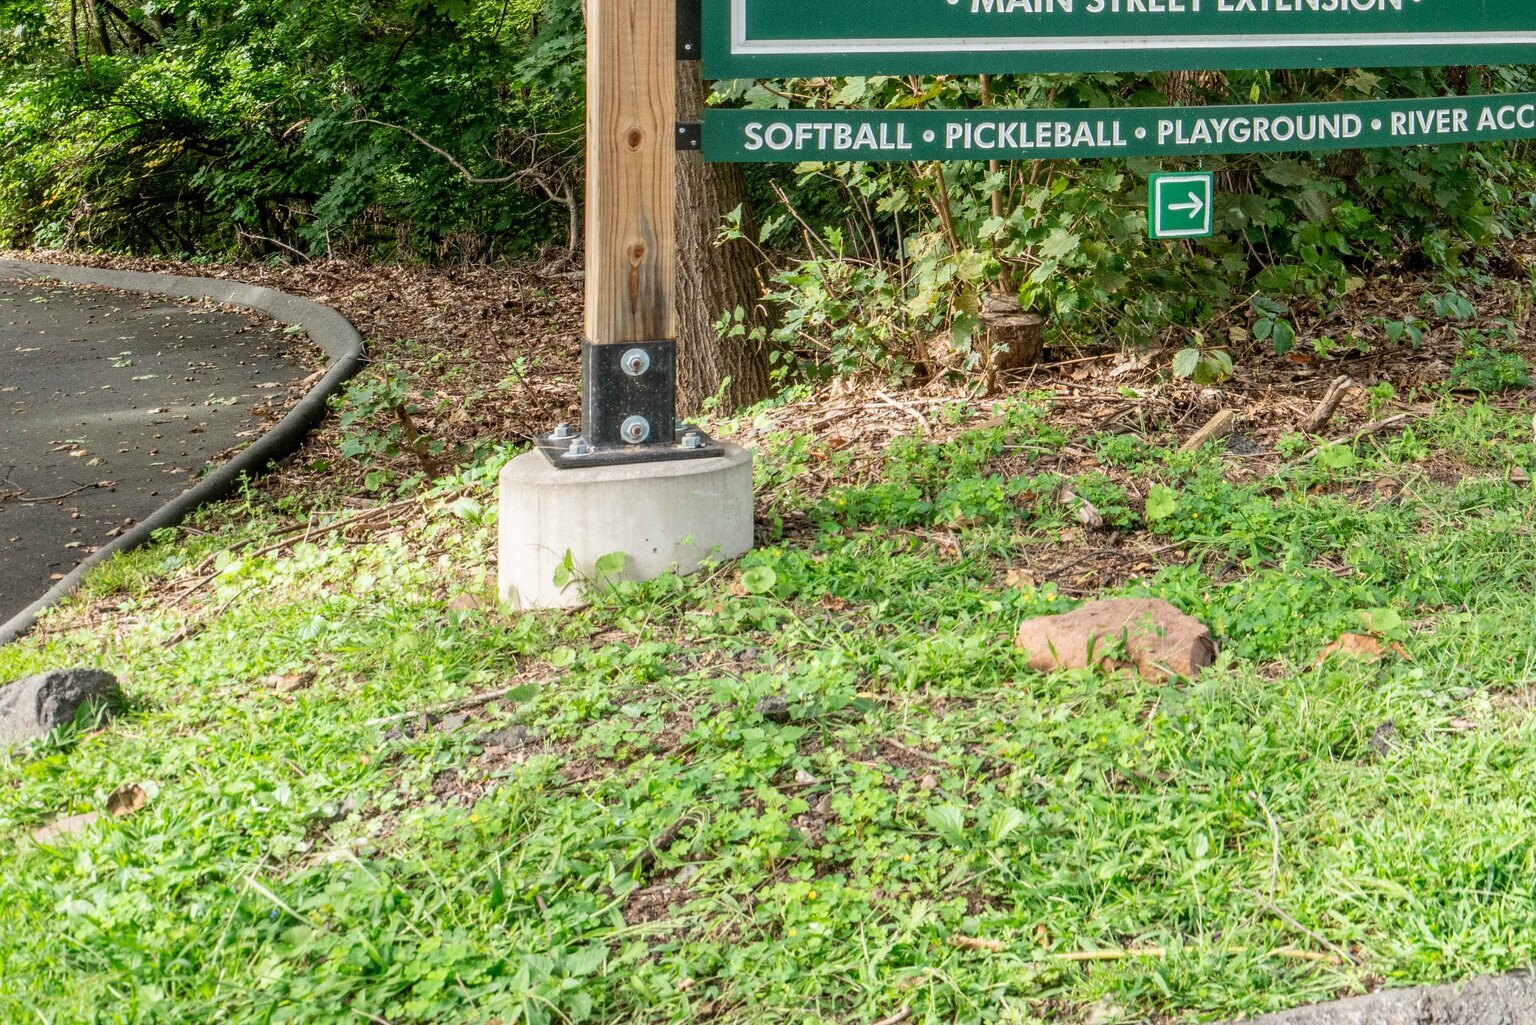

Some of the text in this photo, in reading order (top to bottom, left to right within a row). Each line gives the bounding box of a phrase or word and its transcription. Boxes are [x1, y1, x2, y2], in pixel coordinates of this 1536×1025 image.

[743, 121, 913, 151] SOFTBALL
[945, 120, 1127, 149] PICKLEBALL
[1157, 113, 1362, 145] PLAYGROUND
[1390, 108, 1469, 136] RIVER
